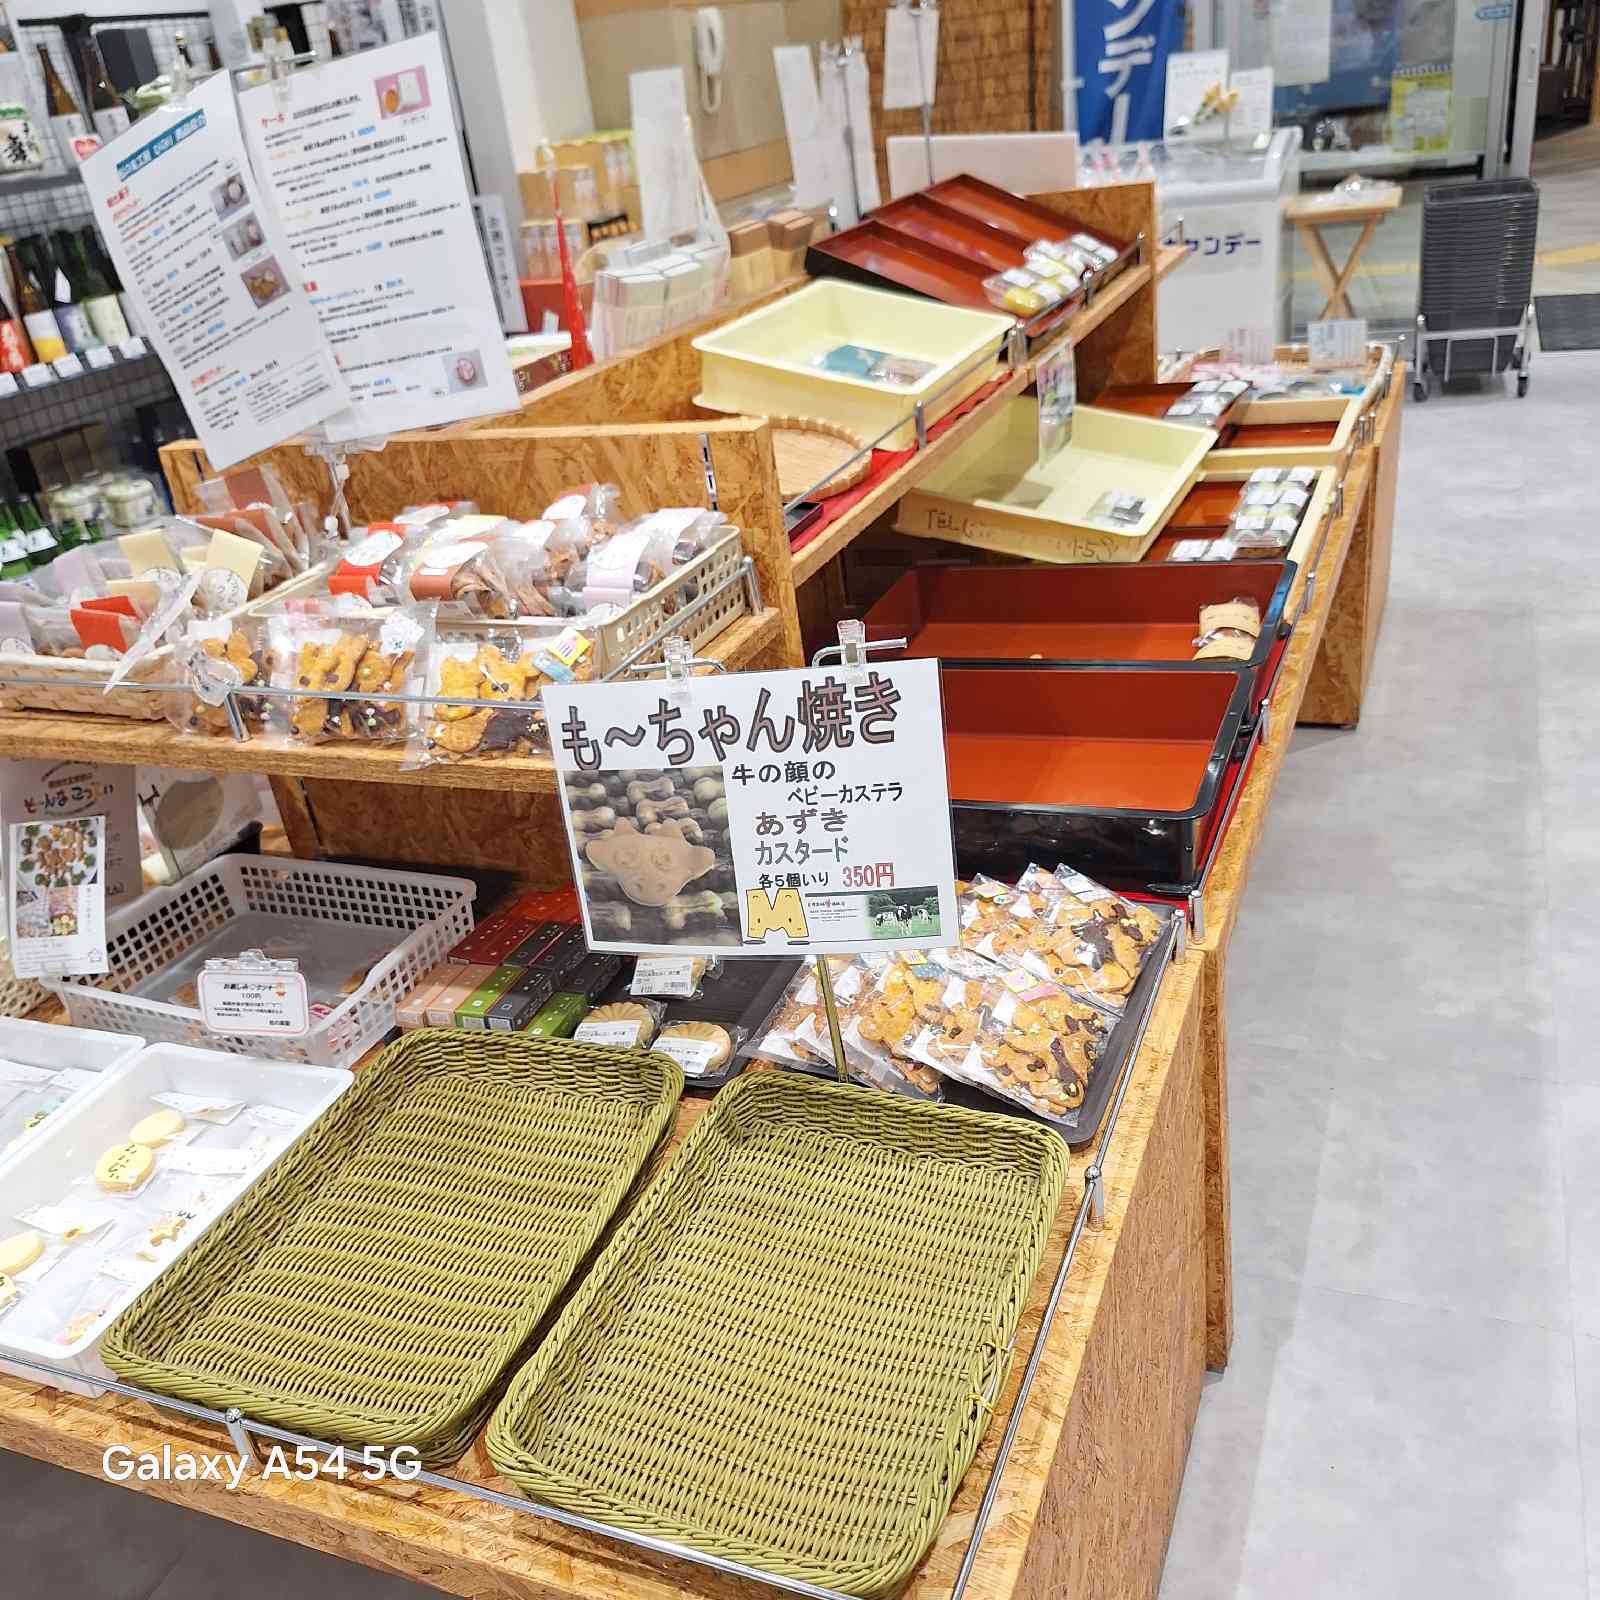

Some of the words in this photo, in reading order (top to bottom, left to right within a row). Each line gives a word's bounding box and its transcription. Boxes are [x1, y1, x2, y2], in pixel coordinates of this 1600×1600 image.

[731, 760, 836, 786] 牛の顔の
[787, 781, 904, 806] ベビーカステラ
[755, 808, 849, 836] あずき
[754, 836, 850, 867] カスタード
[841, 863, 896, 889] 350円
